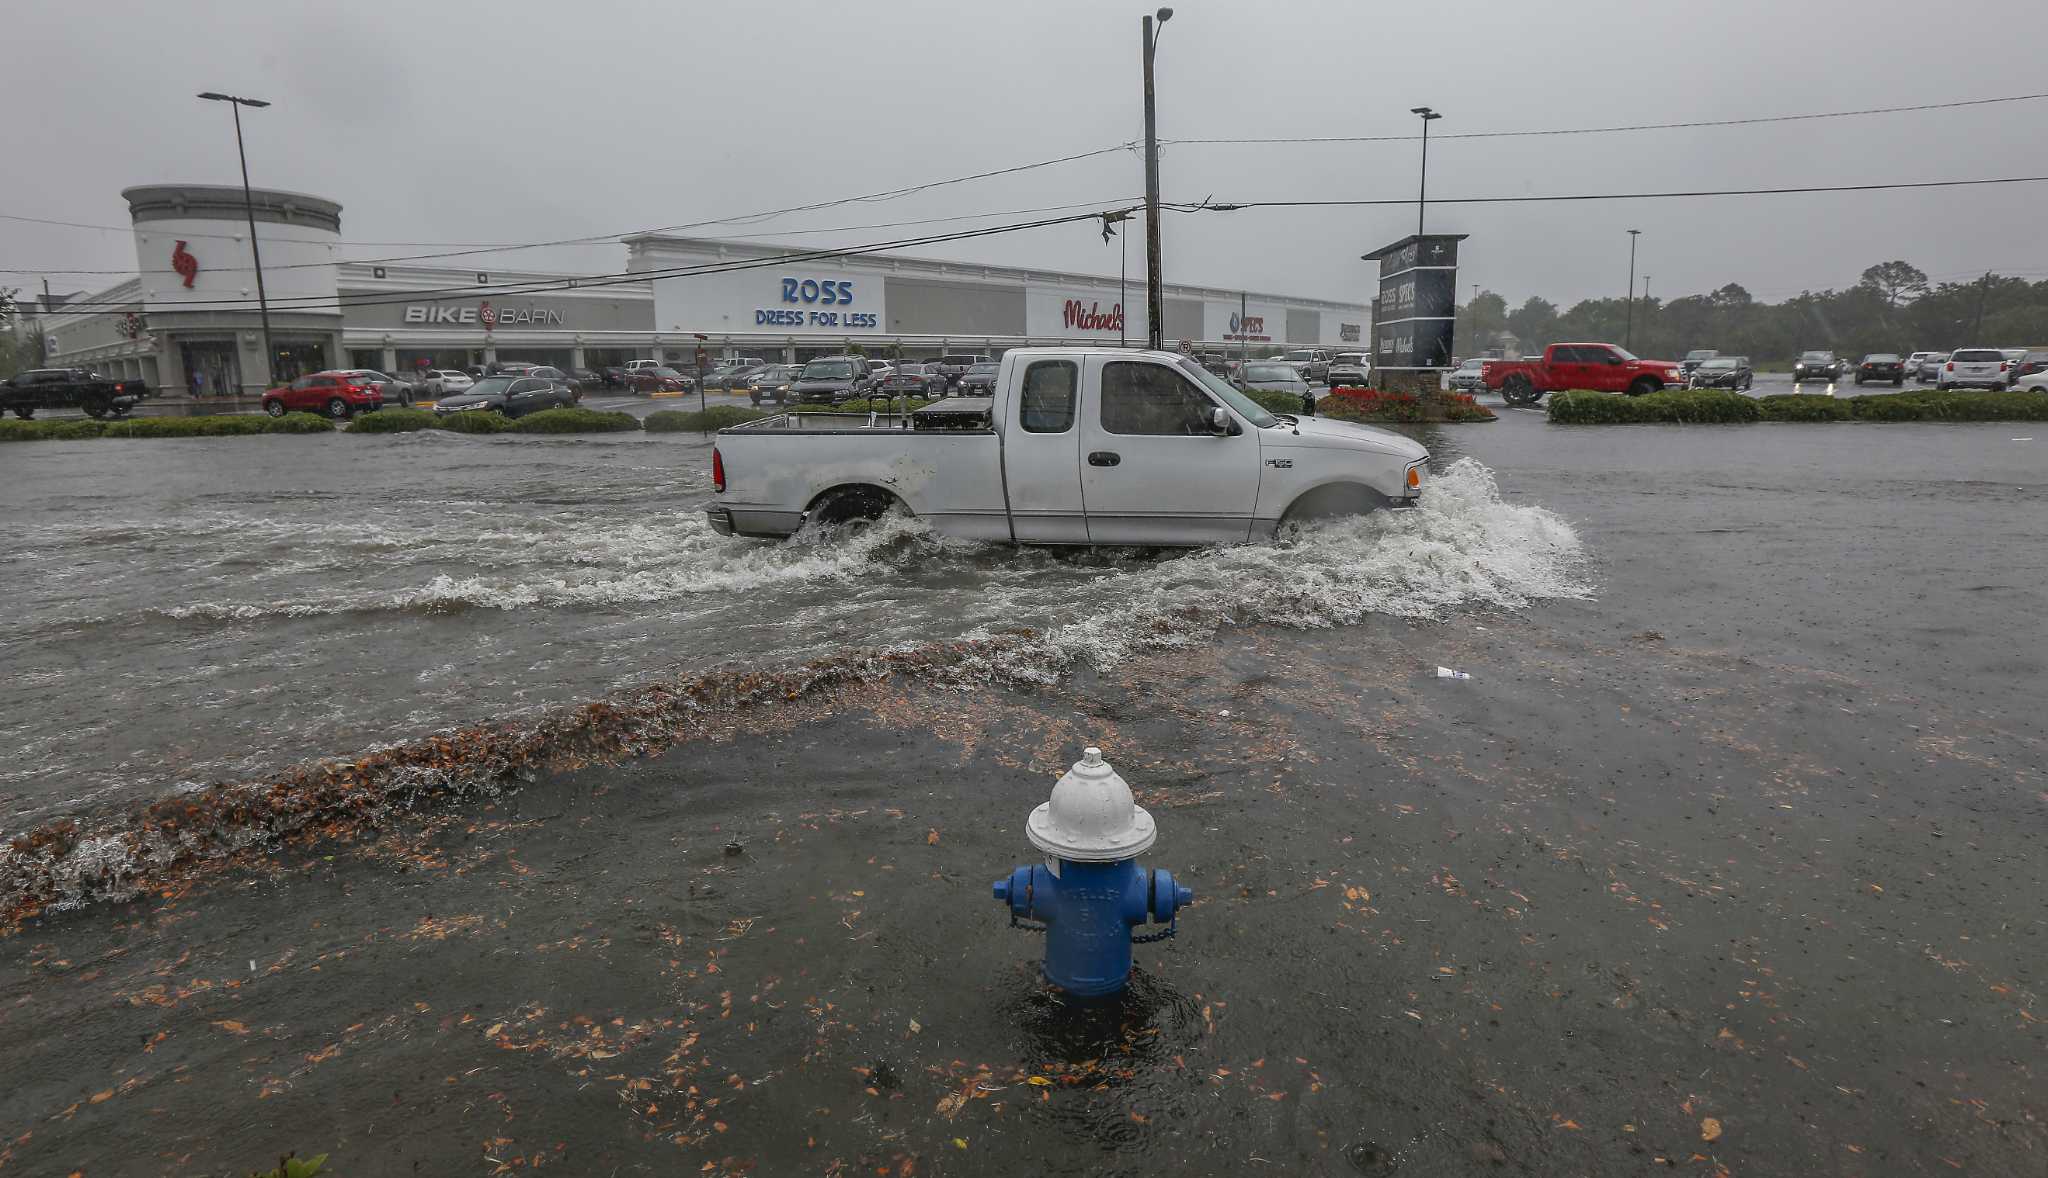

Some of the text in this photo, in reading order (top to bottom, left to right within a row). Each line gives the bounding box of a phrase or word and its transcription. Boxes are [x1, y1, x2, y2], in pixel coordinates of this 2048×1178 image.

[782, 278, 853, 305] ROSS
[406, 305, 565, 324] BIKE BARN
[756, 309, 877, 327] DRESS FOR LESS
[1063, 299, 1124, 331] Michaels
